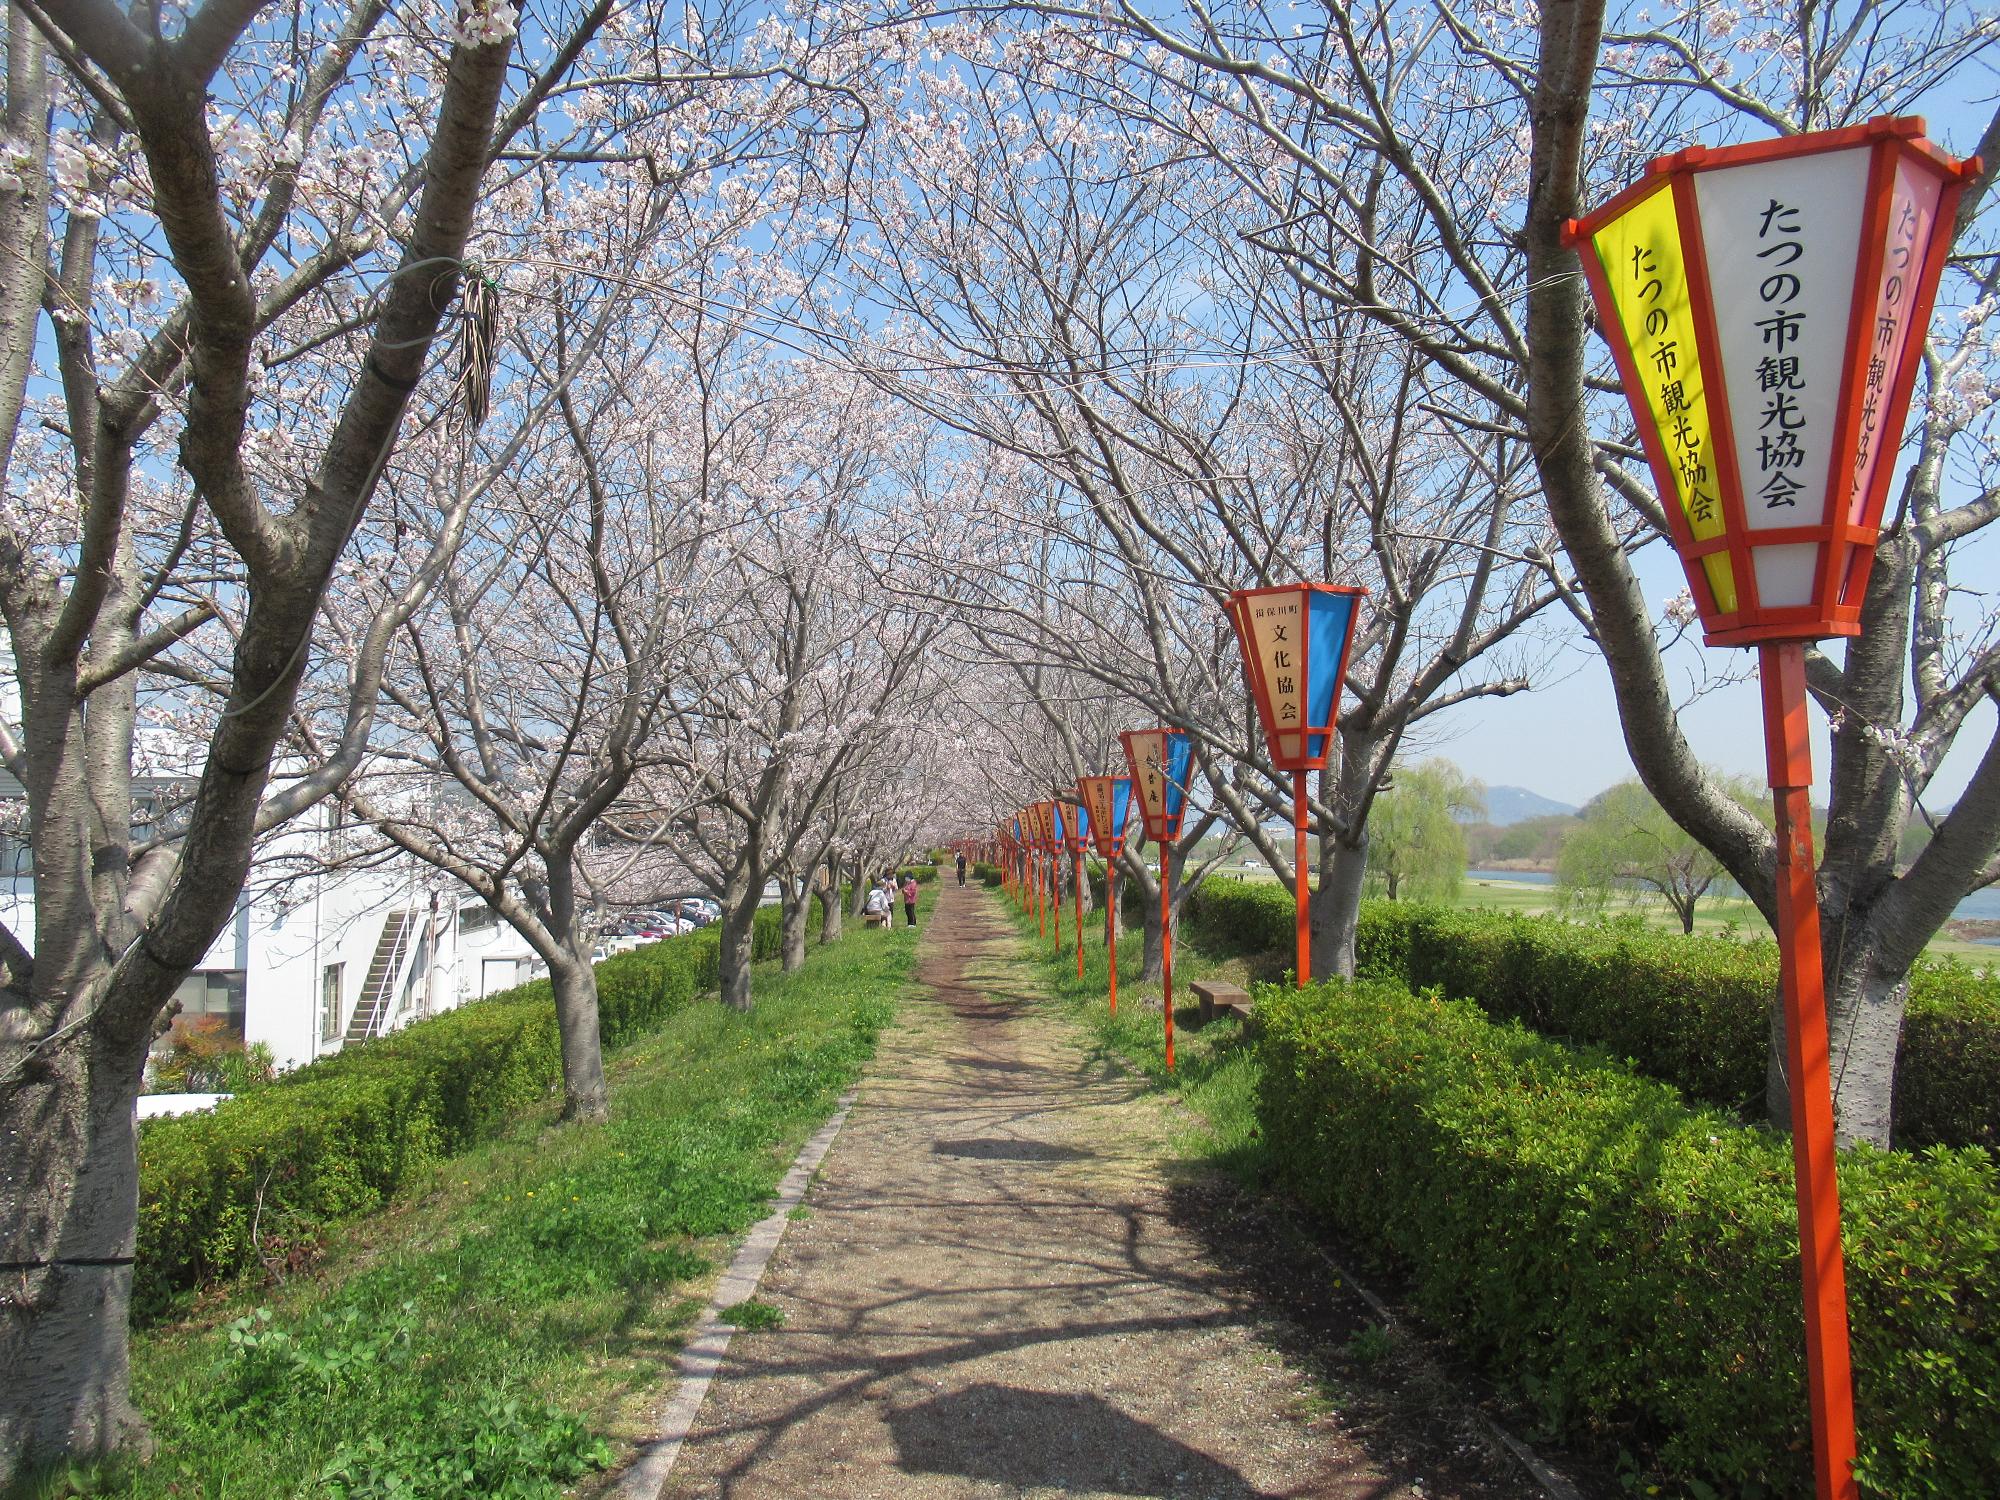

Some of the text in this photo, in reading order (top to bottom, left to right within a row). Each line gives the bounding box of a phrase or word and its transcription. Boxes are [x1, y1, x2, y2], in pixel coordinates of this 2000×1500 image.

[1630, 244, 1715, 523] たつの市観光協会
[1754, 198, 1807, 510] たつの市観光協会
[1272, 624, 1297, 721] 文化協会
